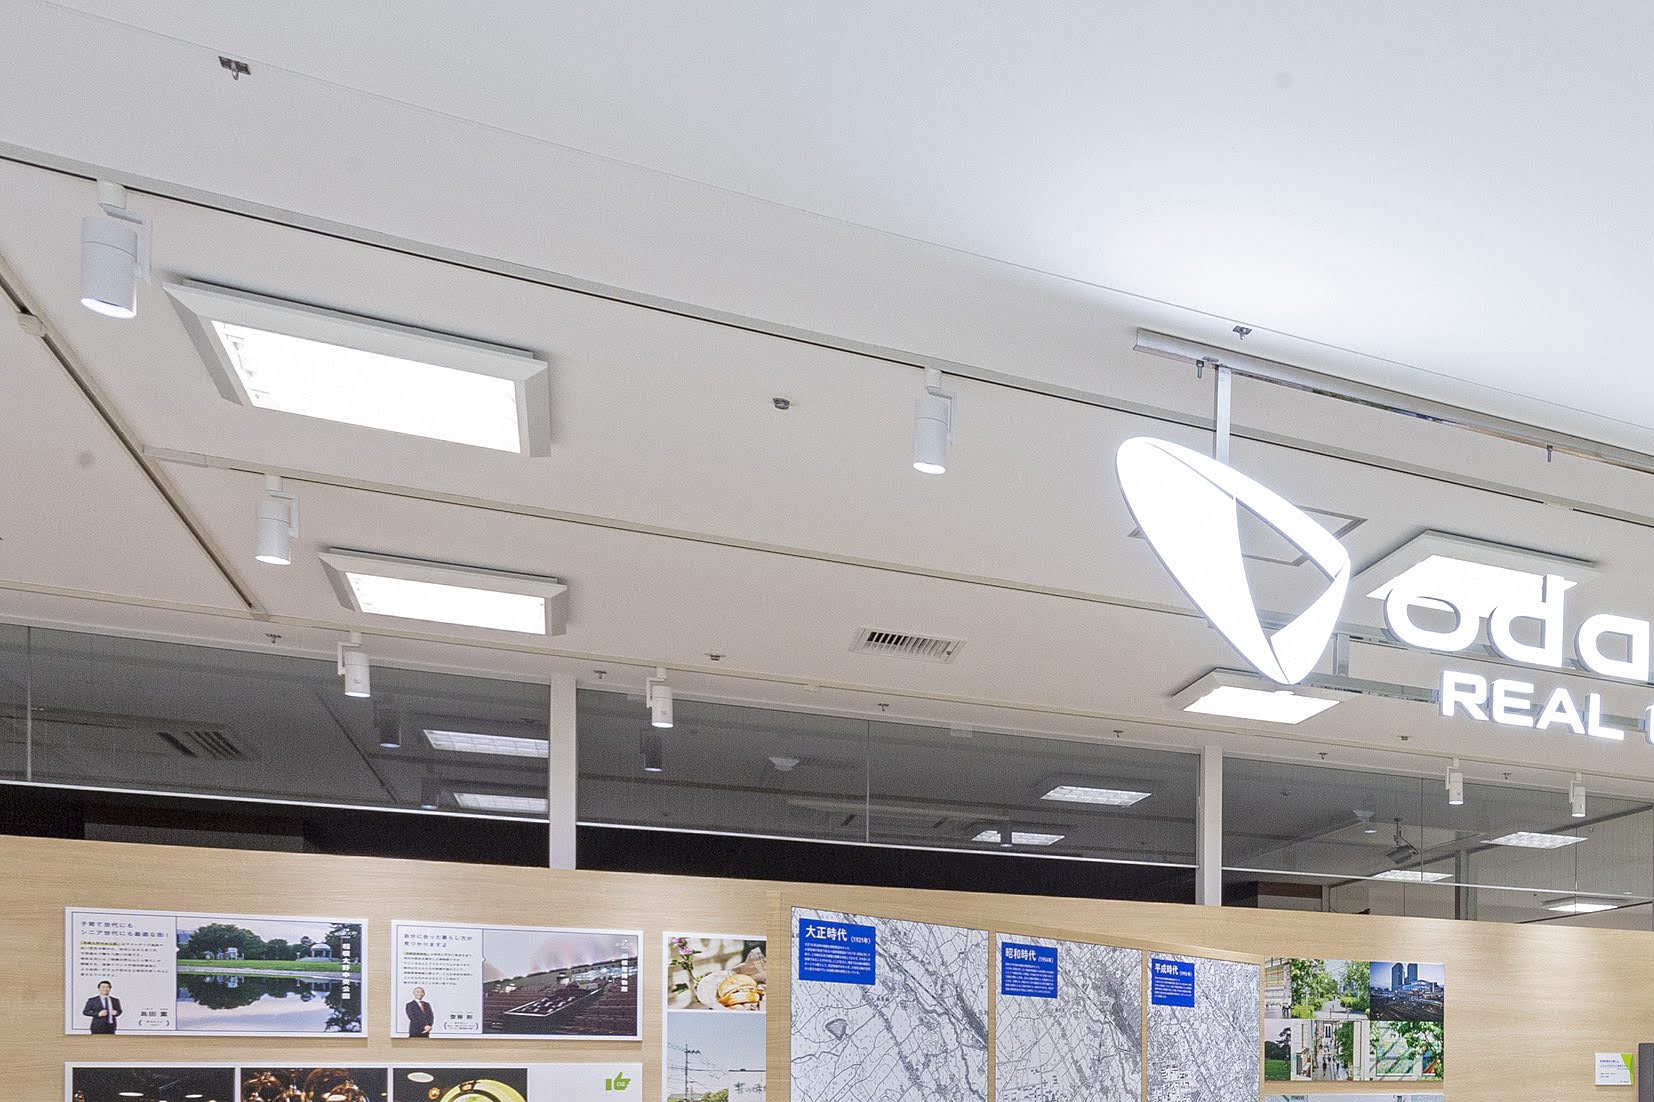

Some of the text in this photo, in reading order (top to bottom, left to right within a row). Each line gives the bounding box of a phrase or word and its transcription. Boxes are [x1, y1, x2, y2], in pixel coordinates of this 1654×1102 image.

[1440, 670, 1625, 741] REAL
[805, 924, 848, 941] 大正時代
[1005, 947, 1037, 961] 昭和時代
[341, 943, 351, 1000] 相模大野中央公園
[1154, 963, 1179, 976] 平成時代
